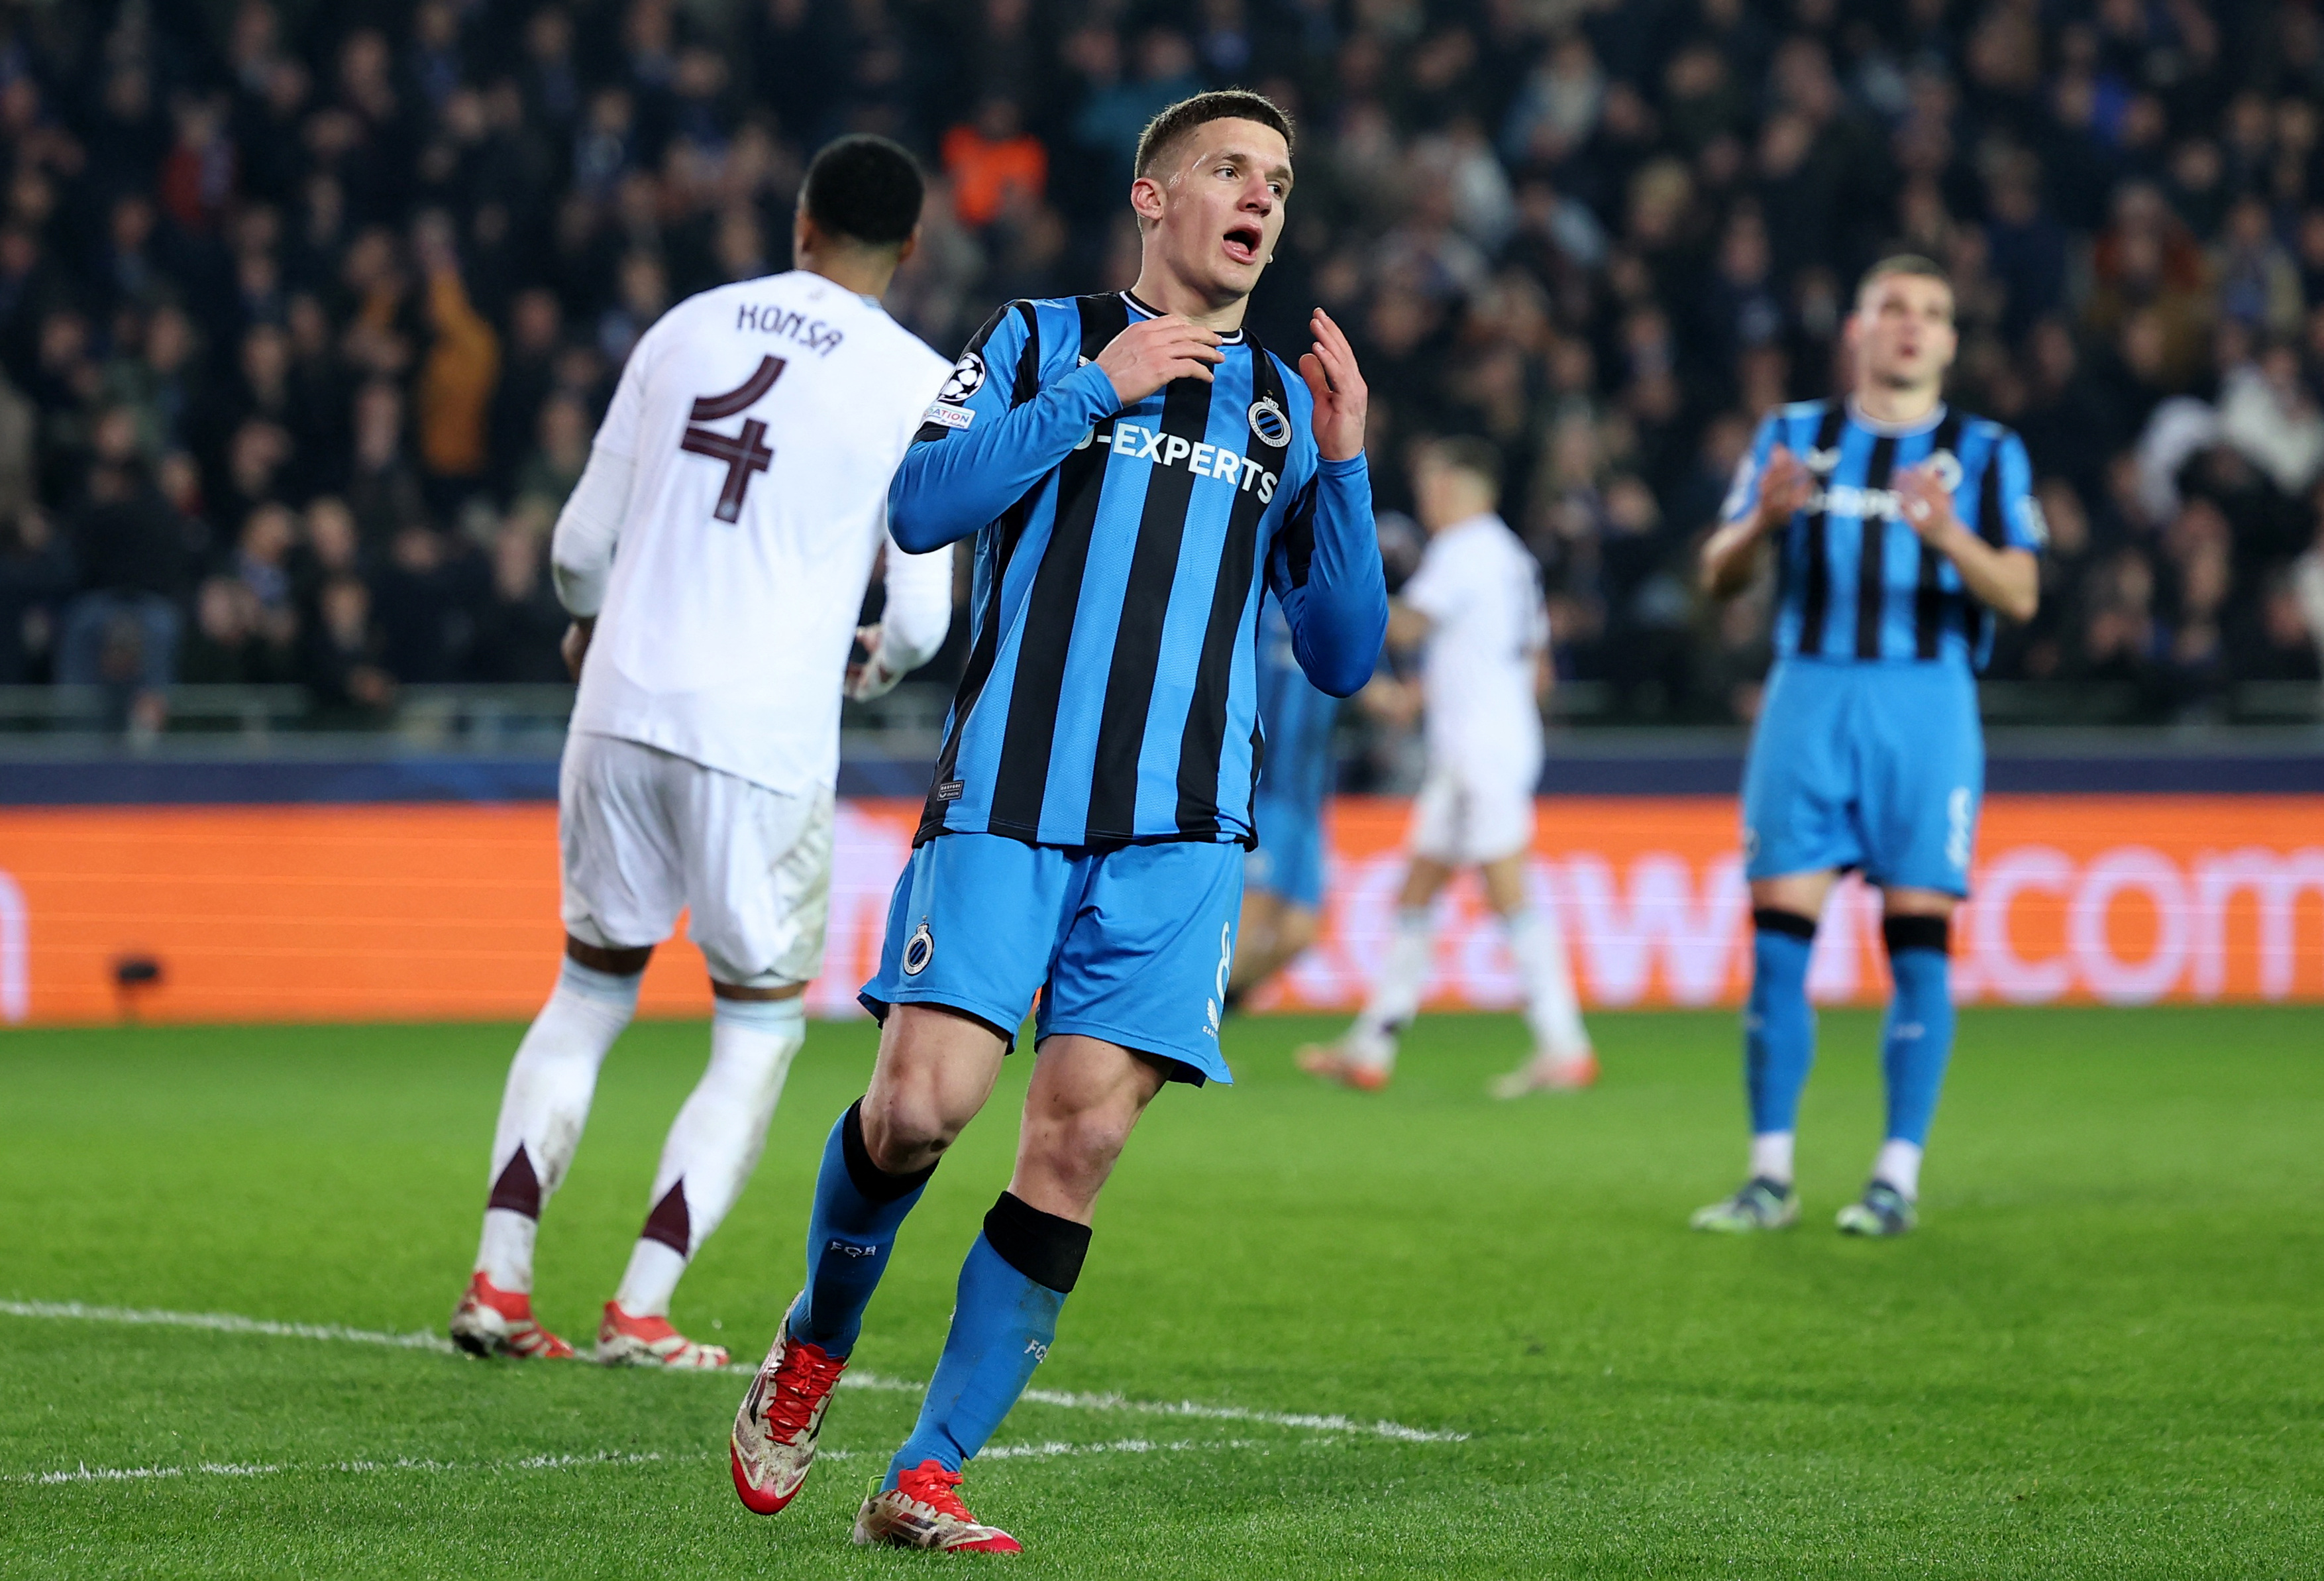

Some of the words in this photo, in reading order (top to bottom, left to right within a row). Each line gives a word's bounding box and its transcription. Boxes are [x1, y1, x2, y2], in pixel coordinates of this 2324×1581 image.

[737, 303, 843, 357] KONSA
[681, 354, 787, 524] 4
[1073, 423, 1278, 504] -EXPERTS
